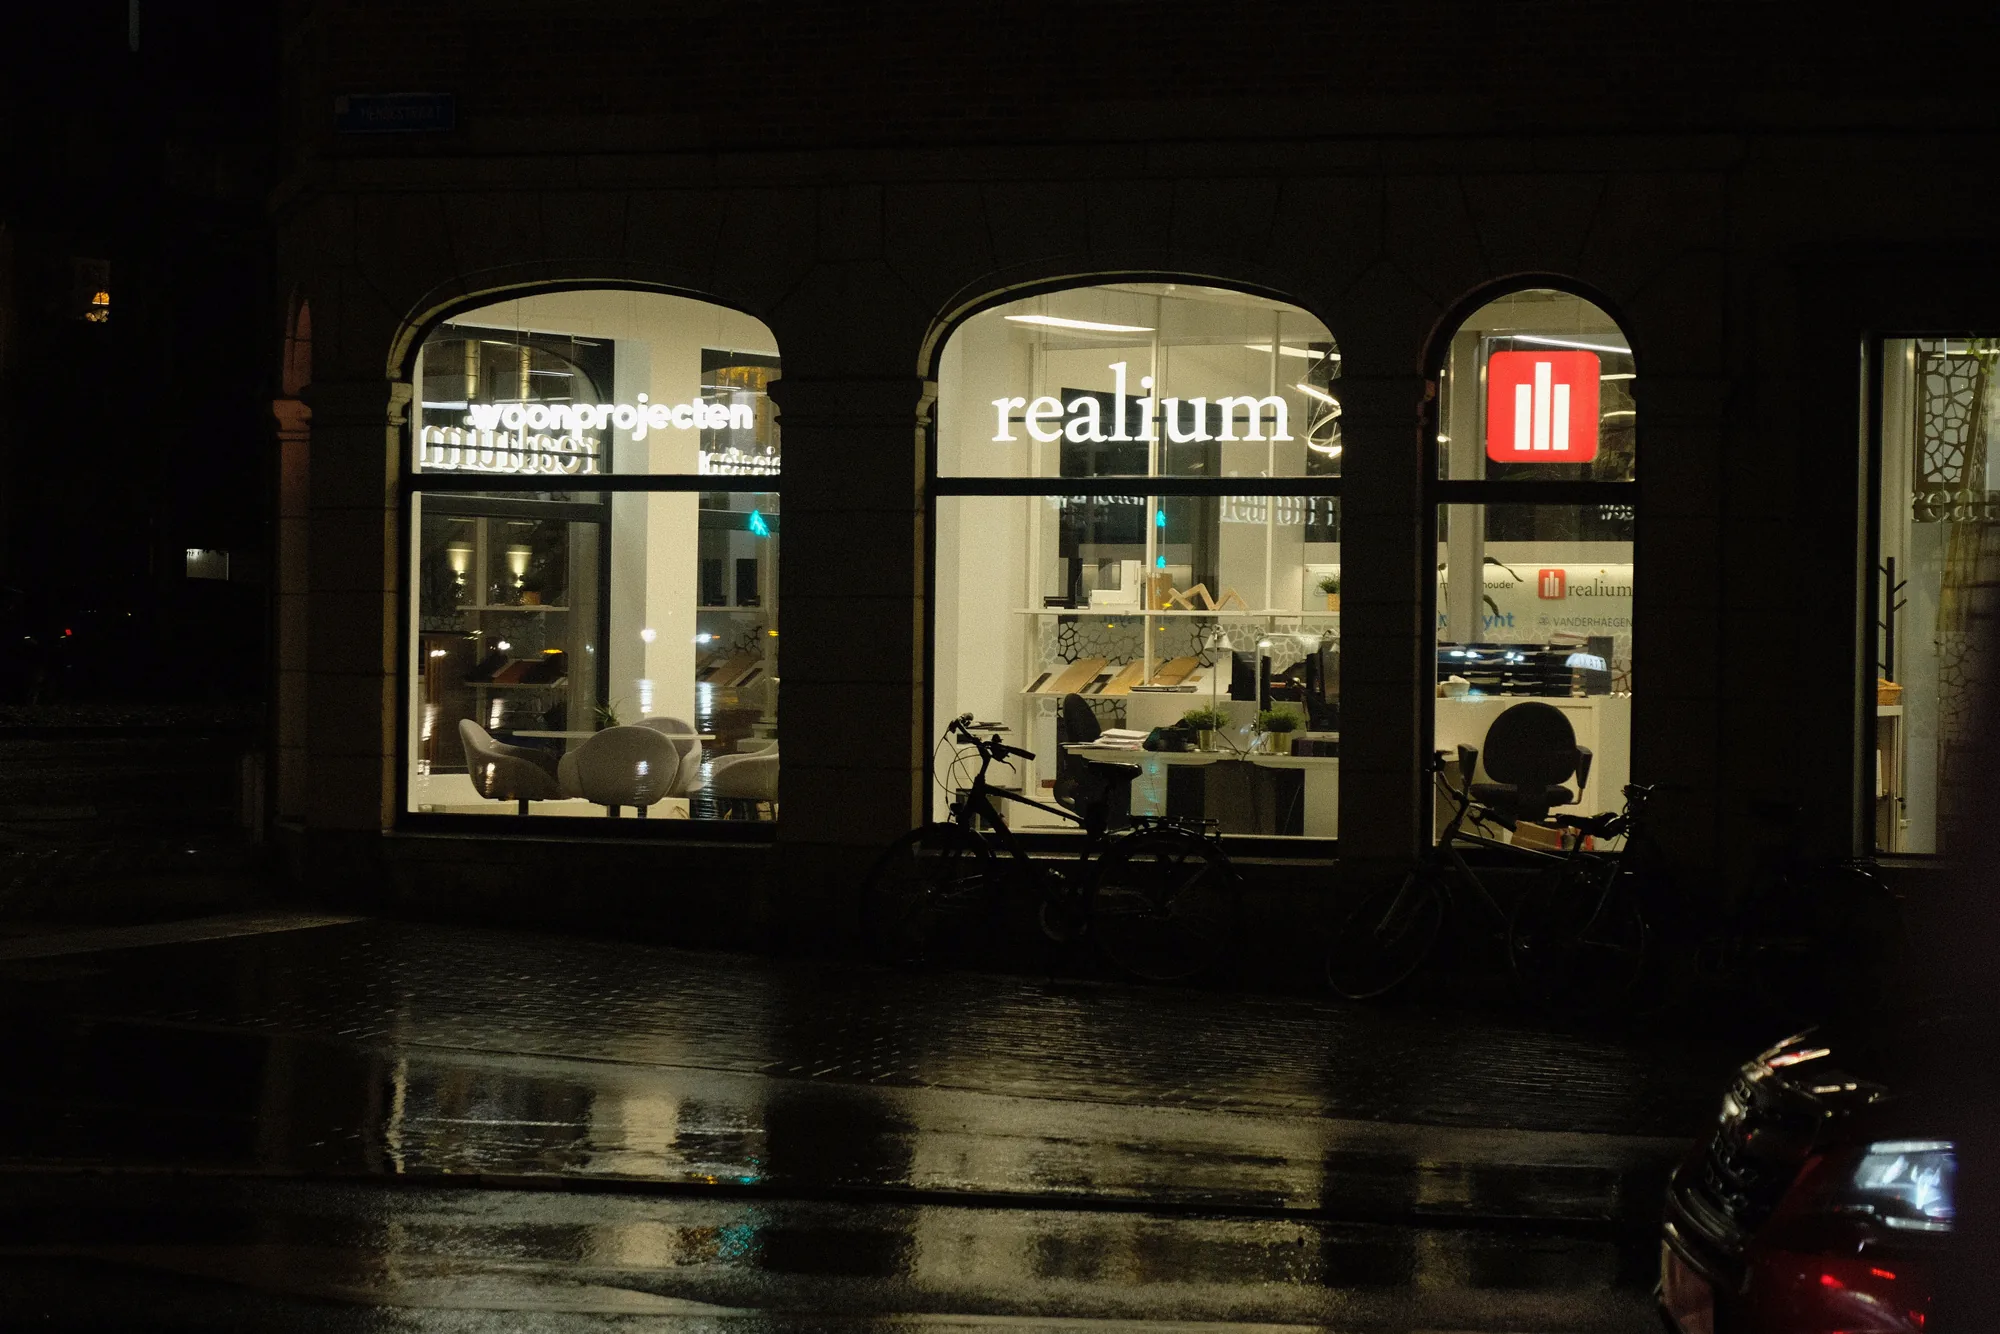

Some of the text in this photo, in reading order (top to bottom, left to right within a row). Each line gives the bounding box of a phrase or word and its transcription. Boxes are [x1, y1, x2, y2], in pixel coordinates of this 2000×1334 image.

[470, 393, 753, 441] woonprojecten
[991, 361, 1294, 443] realium
[1568, 578, 1632, 597] realium
